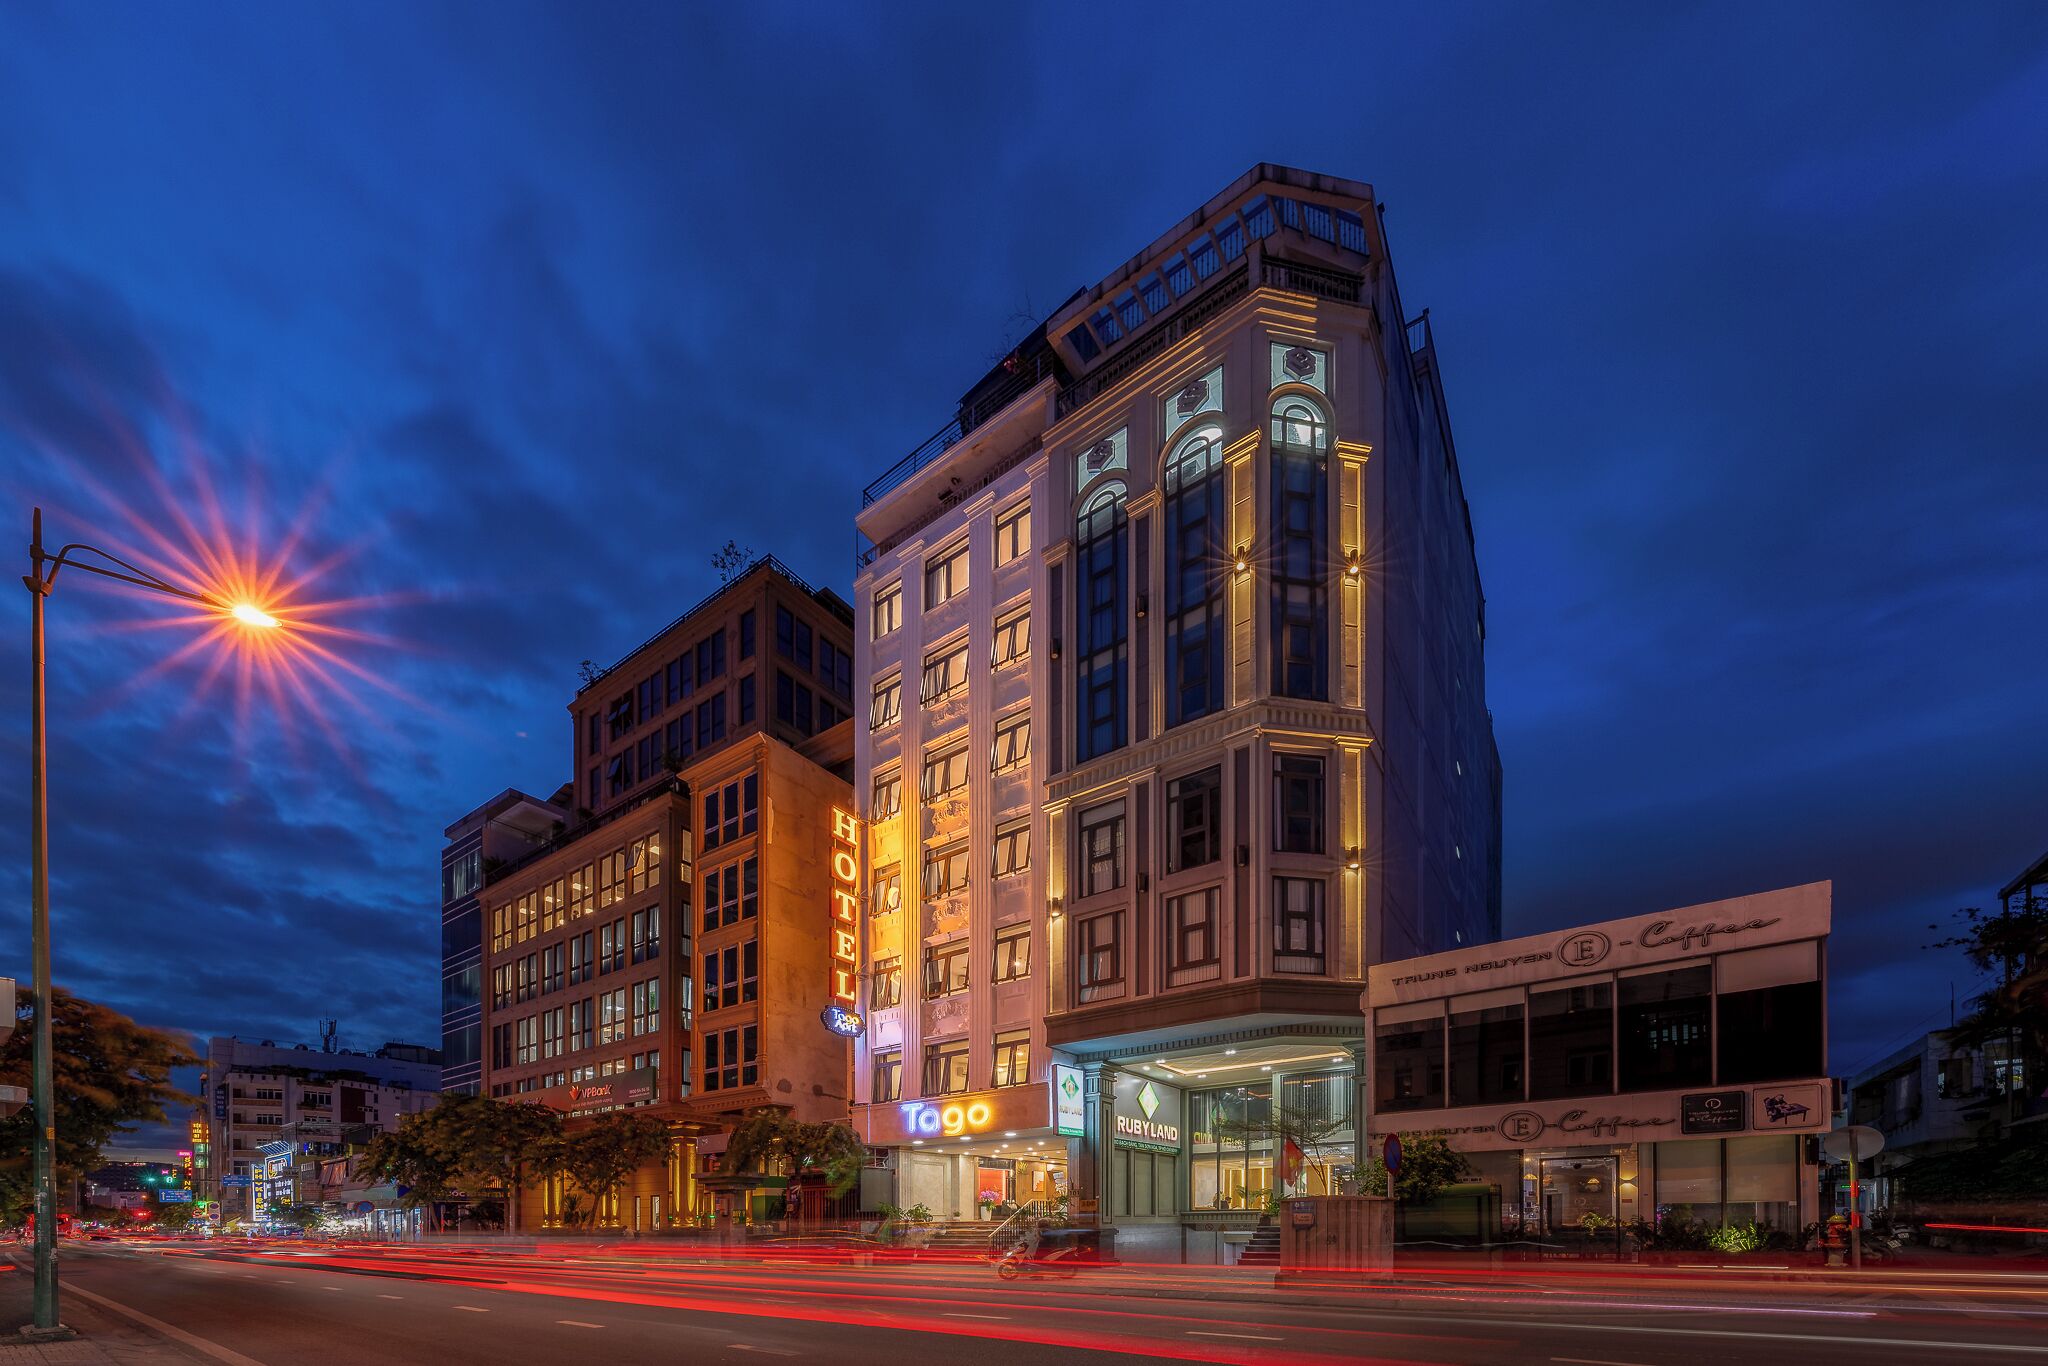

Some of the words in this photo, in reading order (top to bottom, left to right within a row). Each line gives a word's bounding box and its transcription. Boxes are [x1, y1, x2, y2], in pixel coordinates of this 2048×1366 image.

[833, 807, 857, 1001] HOTEL
[1392, 968, 1457, 985] TRUNG
[1465, 951, 1553, 974] NGUYEN
[1640, 908, 1781, 950] Coffee
[831, 1008, 860, 1025] Tago
[582, 1083, 612, 1099] VPBank
[901, 1102, 990, 1134] Tago
[1117, 1115, 1178, 1141] RUBYLAND
[1559, 1110, 1676, 1137] Coffee
